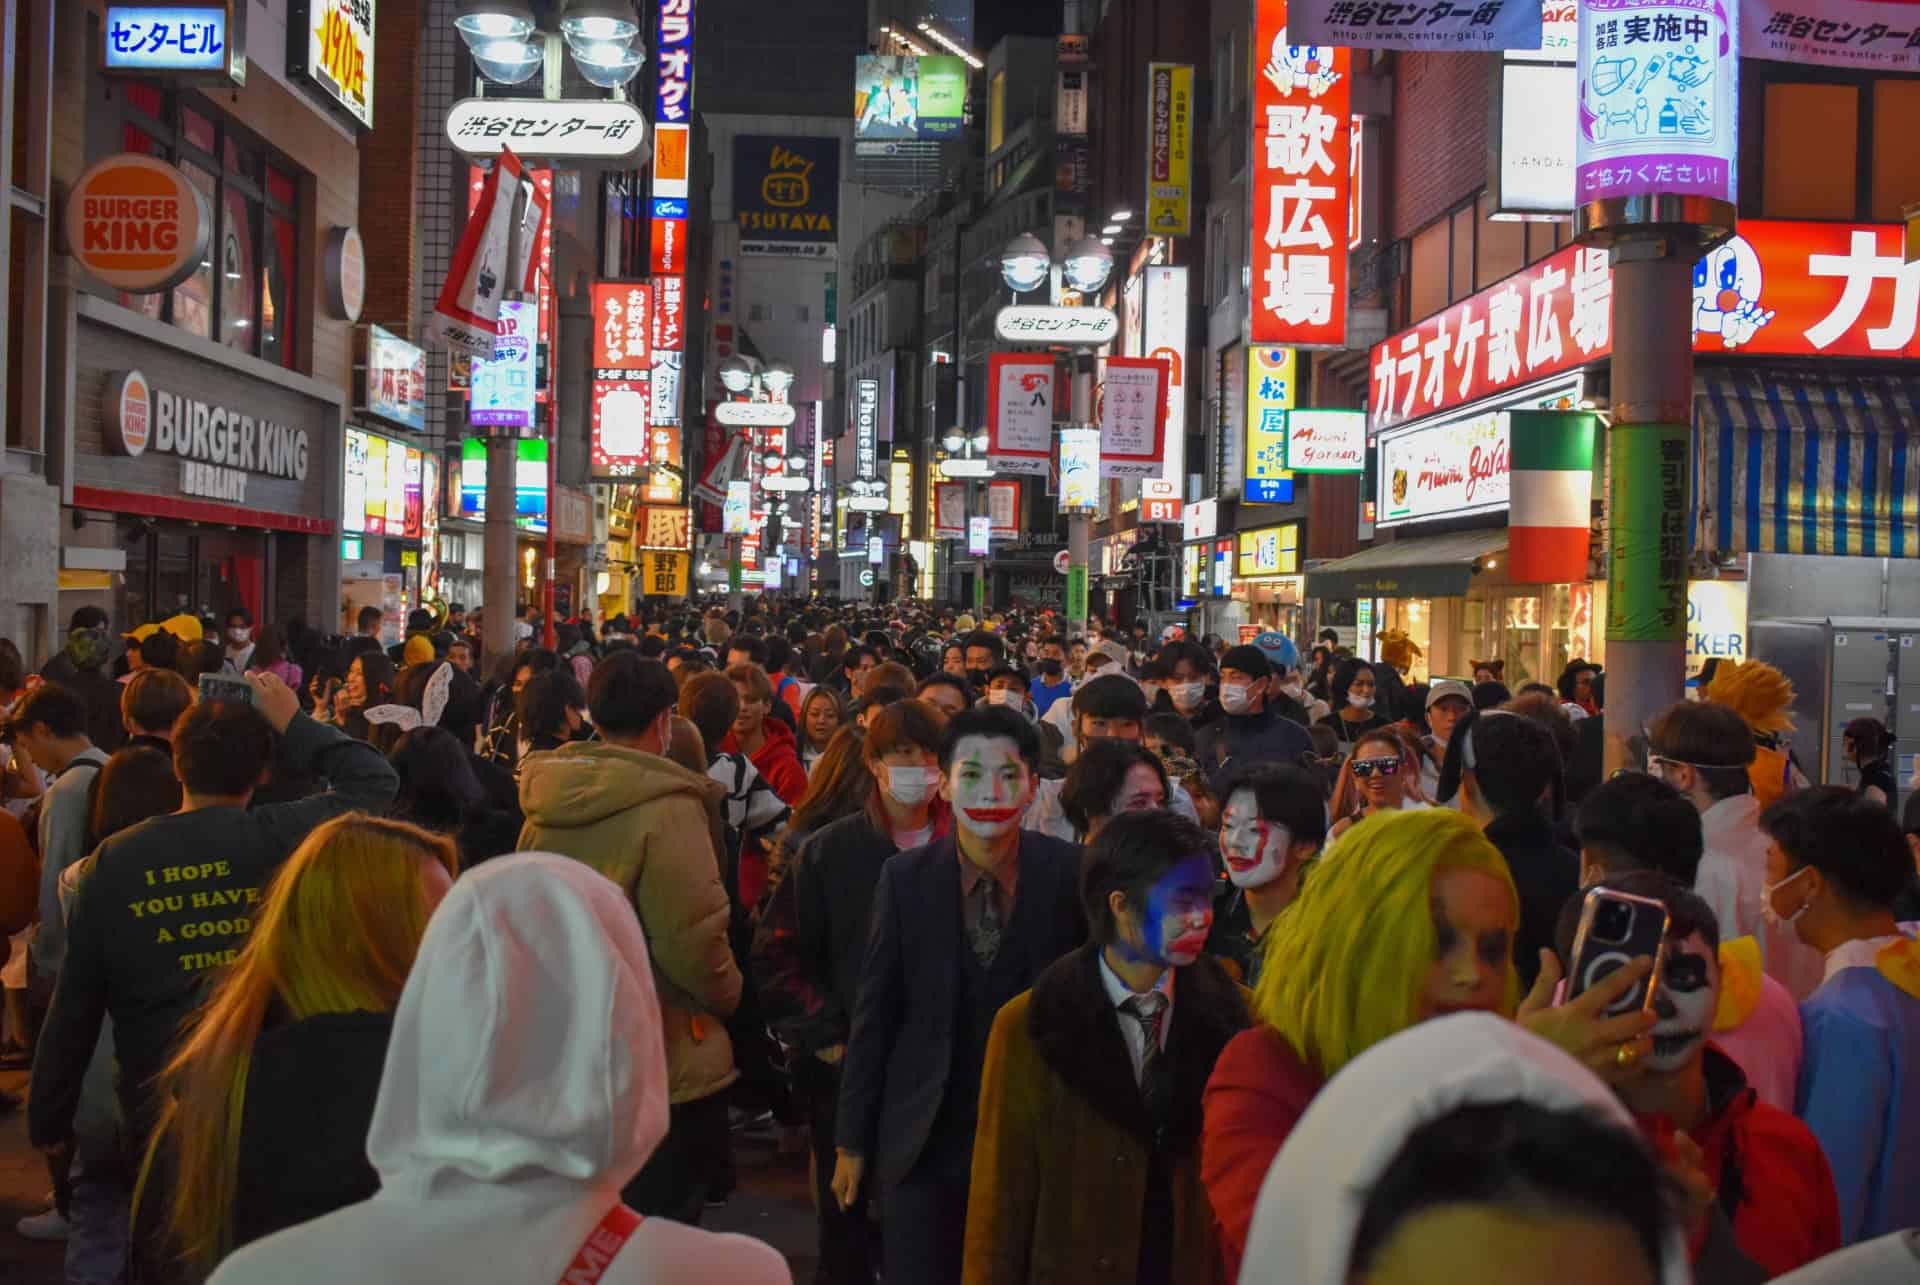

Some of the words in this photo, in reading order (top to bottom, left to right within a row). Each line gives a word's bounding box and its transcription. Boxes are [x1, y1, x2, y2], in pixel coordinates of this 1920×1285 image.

[111, 22, 222, 54] センタービル
[1623, 14, 1708, 45] 実施中
[457, 116, 635, 140] 渋谷センター街
[1584, 163, 1718, 190] ご協力ください!
[84, 199, 178, 220] BURGER
[738, 212, 832, 231] TSUTAYA
[1263, 104, 1337, 326] 歌広場
[84, 221, 178, 250] KING
[605, 297, 623, 363] もんじゃ
[1374, 247, 1612, 428] カラオケ歌広場
[1259, 376, 1285, 433] 松屋
[155, 390, 255, 471] BURGER
[259, 419, 308, 481] KING
[1262, 490, 1276, 499] 1F
[1151, 502, 1173, 518] B1
[648, 510, 686, 547] 豚
[654, 553, 678, 593] 野郎
[145, 870, 157, 886] I
[163, 860, 231, 883] HOPE
[128, 895, 184, 918] YOU
[191, 887, 259, 909] HAVE
[157, 928, 176, 944] A
[180, 918, 252, 939] GOOD
[179, 949, 238, 971] TIME
